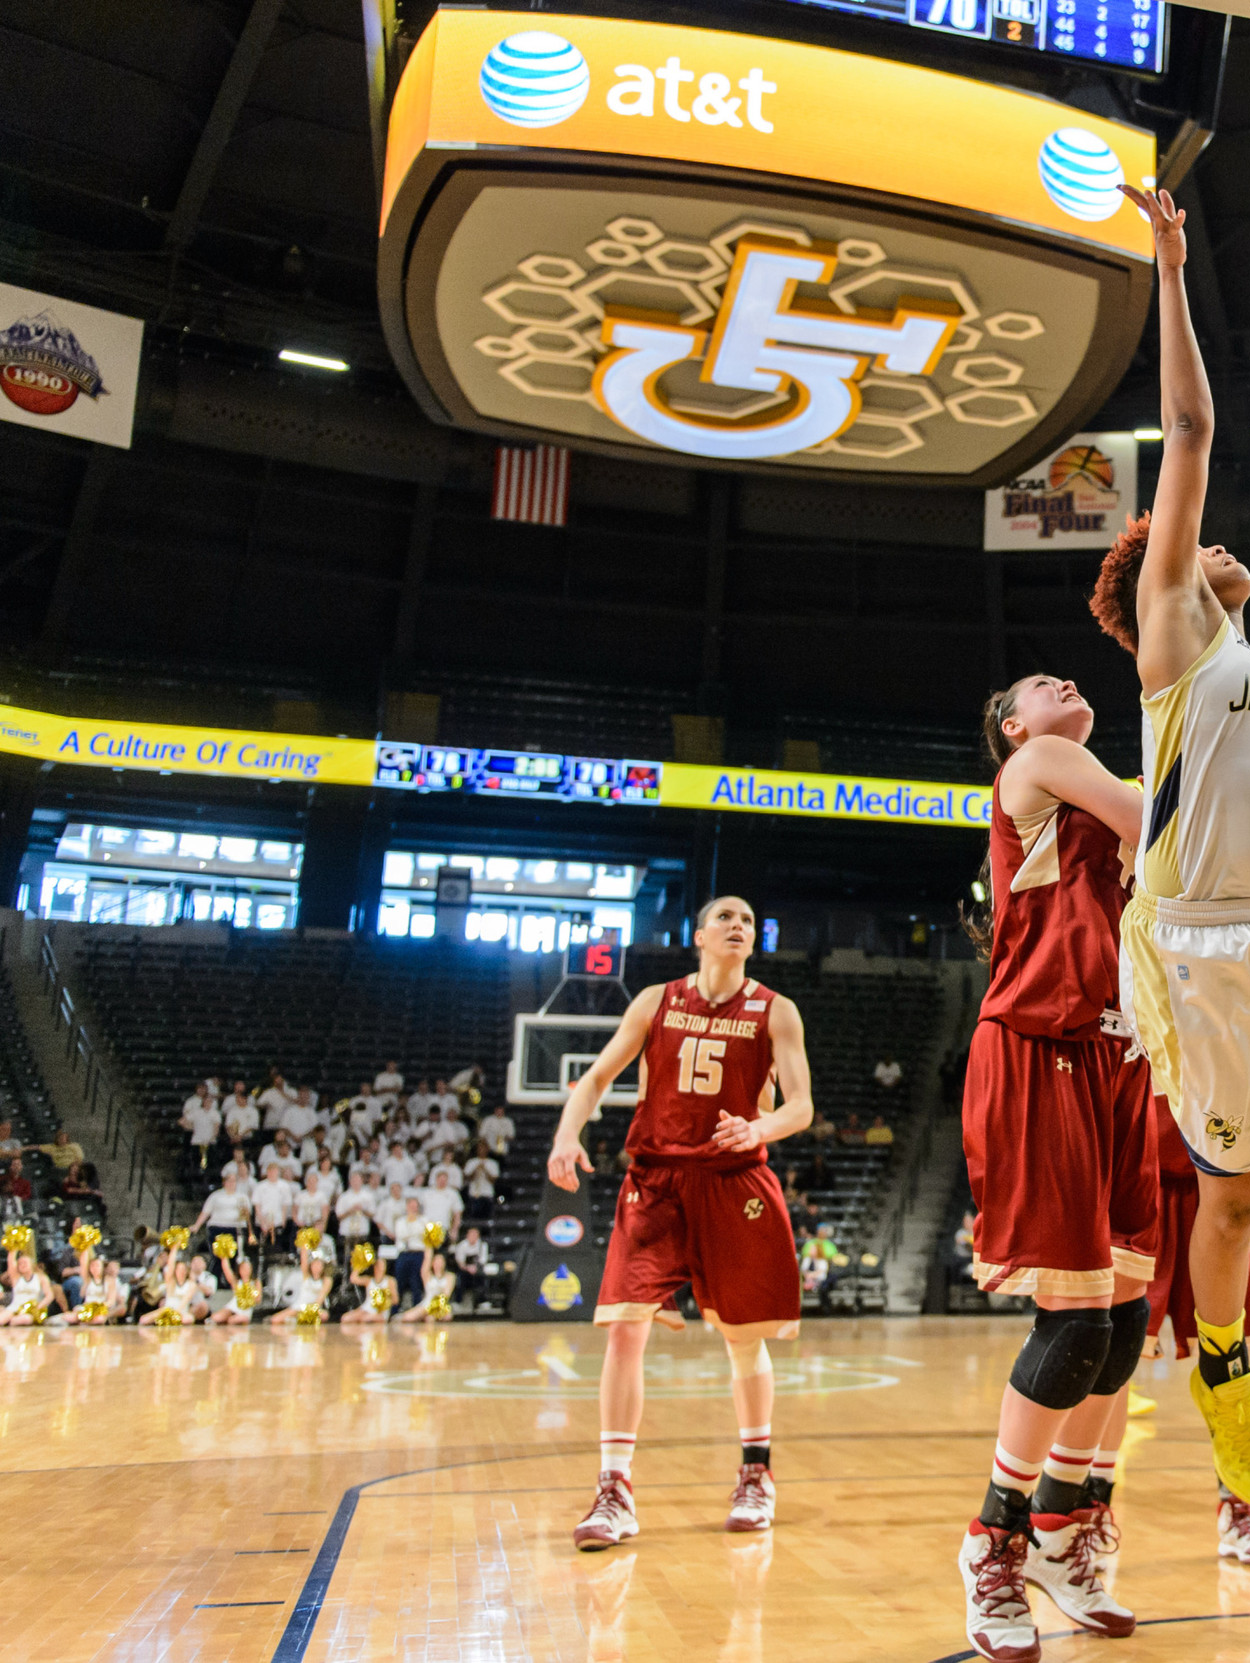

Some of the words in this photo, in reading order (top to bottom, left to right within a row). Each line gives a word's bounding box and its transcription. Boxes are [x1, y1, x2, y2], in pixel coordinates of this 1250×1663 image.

[1007, 21, 1022, 41] 2
[1055, 17, 1075, 33] 44
[1095, 25, 1108, 40] 4
[1132, 13, 1149, 29] 17
[1094, 41, 1107, 57] 4
[14, 367, 63, 391] 1990
[1003, 490, 1074, 517] Final
[1039, 513, 1105, 538] Four
[59, 730, 81, 753] A
[89, 732, 186, 763] Culture
[197, 741, 230, 765] Of
[711, 774, 825, 810] Atlanta
[834, 783, 955, 820] Medical
[586, 944, 612, 975] 15
[663, 1010, 710, 1033] BOSTON
[710, 1018, 758, 1039] COLLEGE
[678, 1036, 727, 1095] 15
